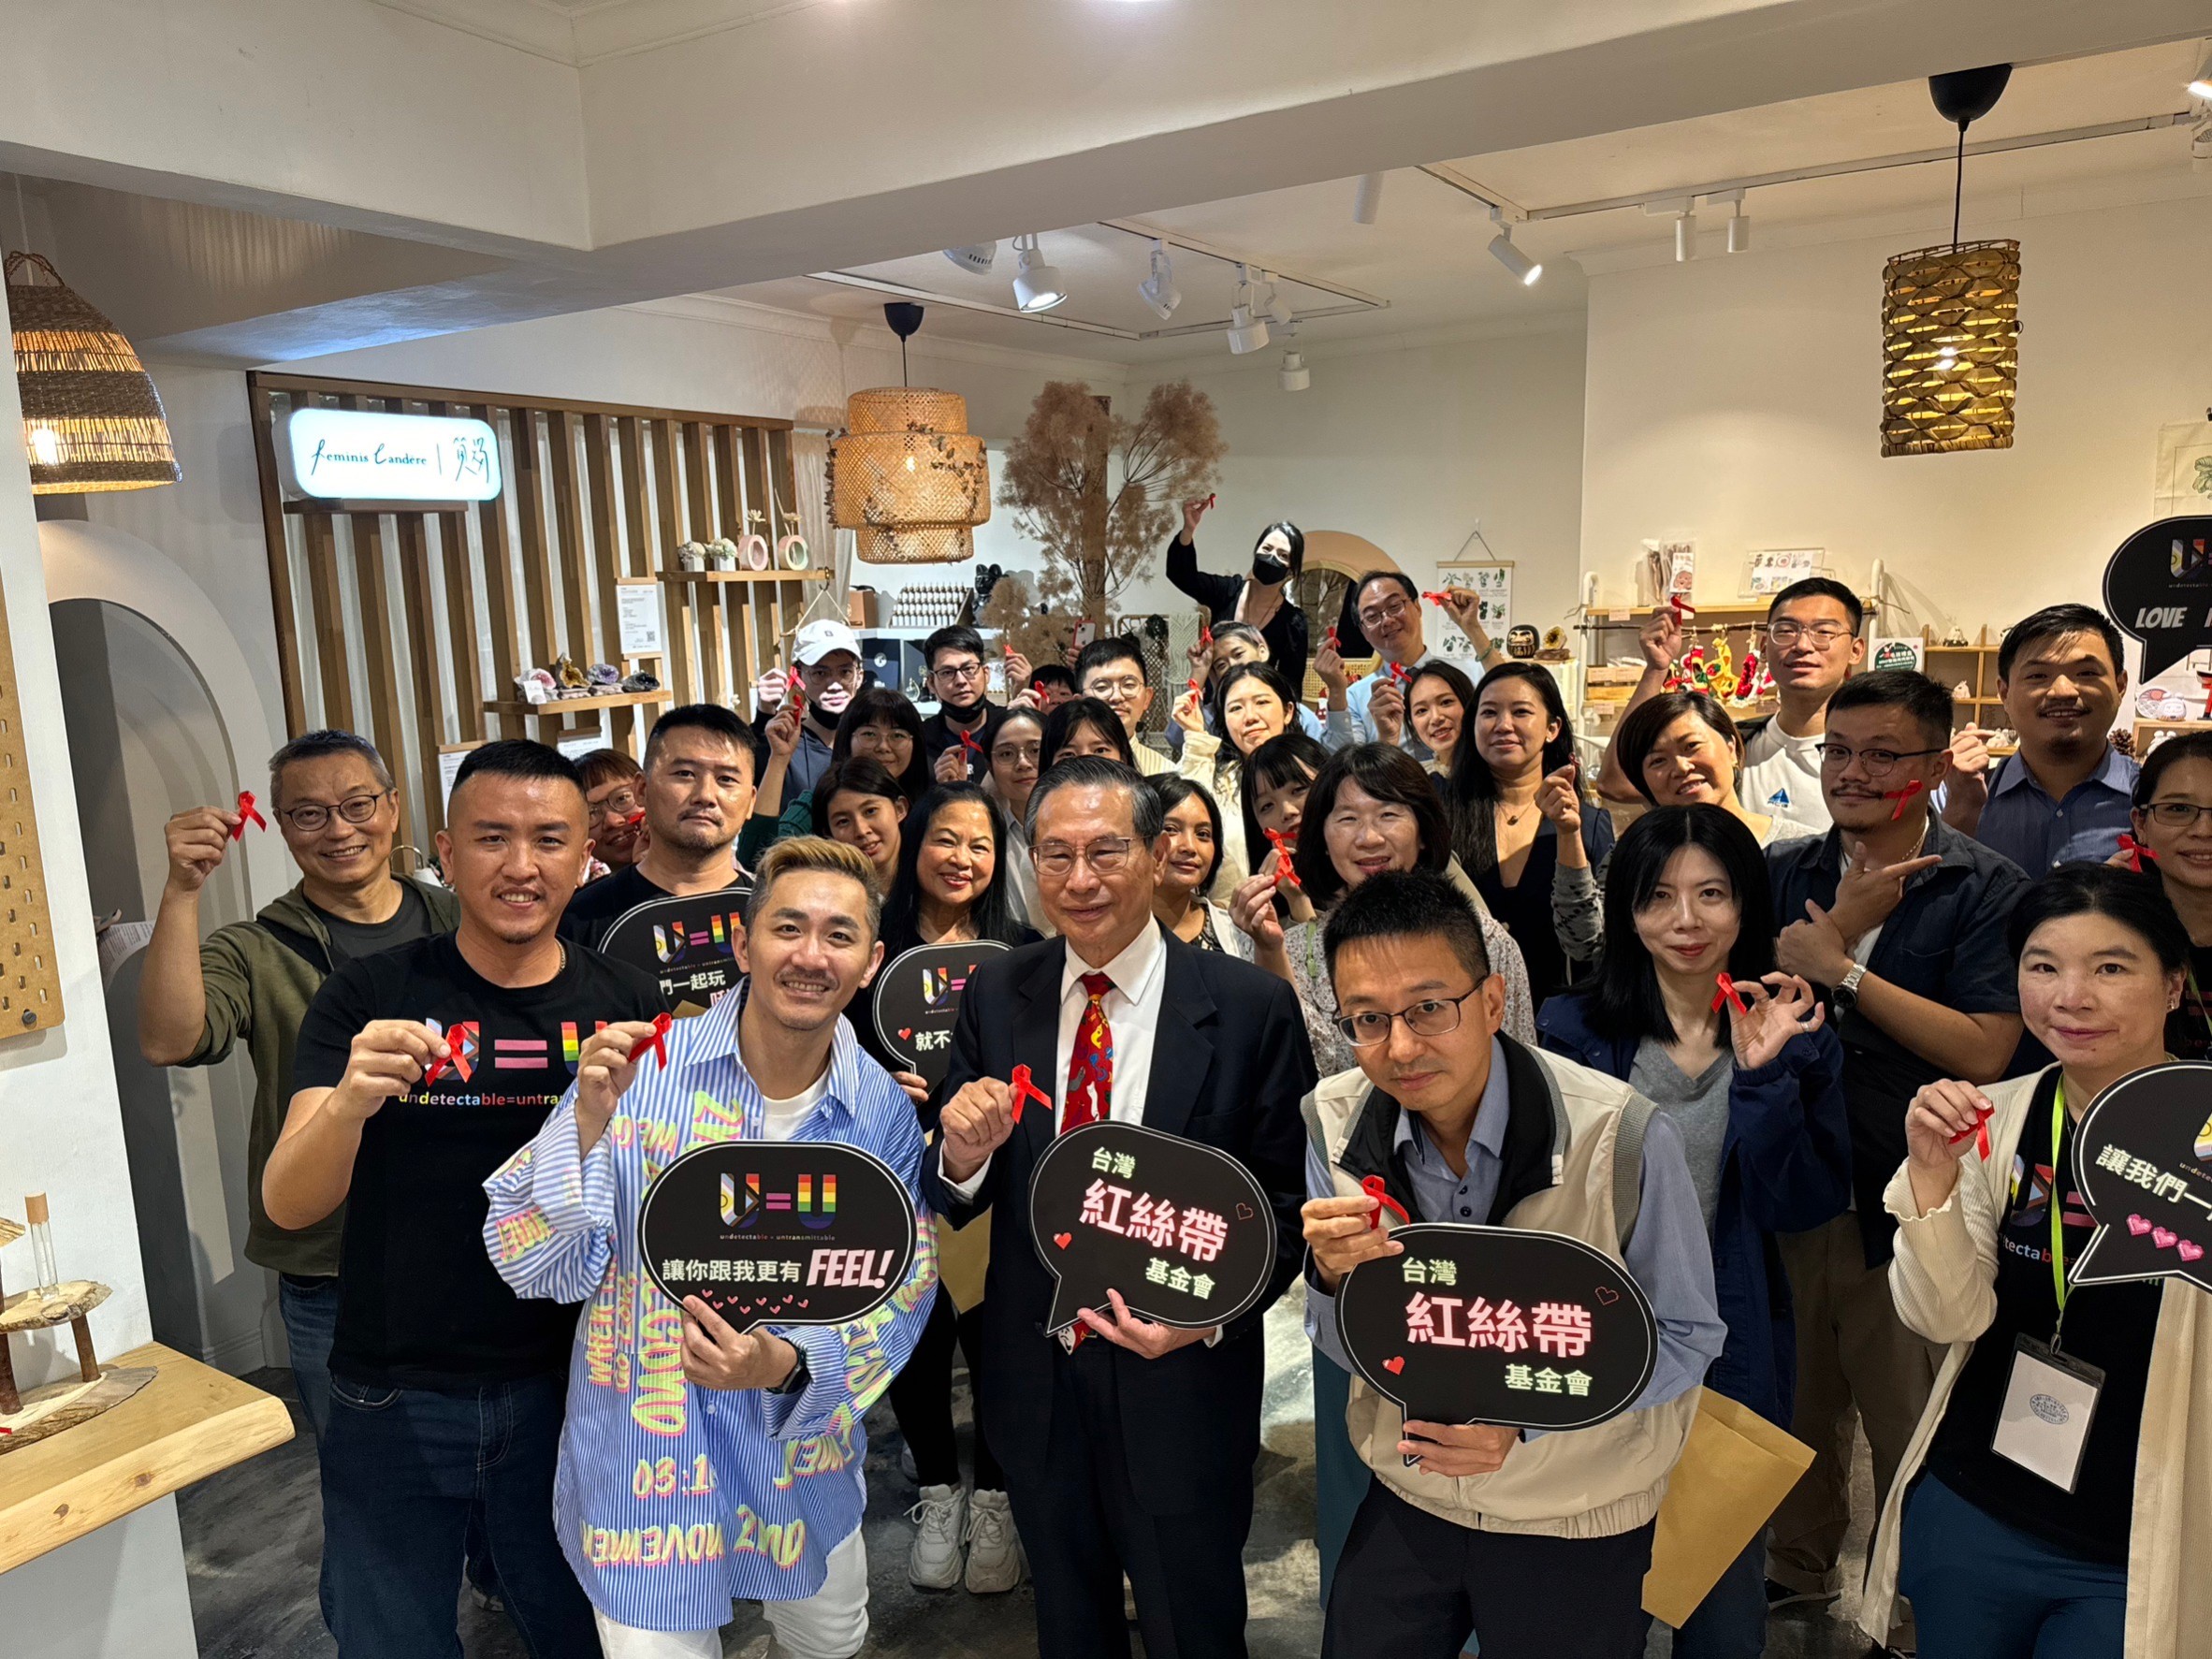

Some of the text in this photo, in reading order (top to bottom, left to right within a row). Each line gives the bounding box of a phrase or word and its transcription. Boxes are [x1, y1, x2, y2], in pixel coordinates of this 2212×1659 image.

[2134, 606, 2188, 629] LOVE
[1091, 1146, 1136, 1179] 台灣
[720, 1172, 837, 1230] U=U
[776, 1233, 836, 1242] untransmittable
[1079, 1178, 1229, 1262] 紅絲帶
[662, 1248, 895, 1289] 讓你跟我更有 FEEL!
[1145, 1258, 1215, 1301] 基金會
[1402, 1257, 1458, 1287] 台灣
[1405, 1291, 1592, 1359] 紅絲帶
[1505, 1363, 1593, 1397] 基金會
